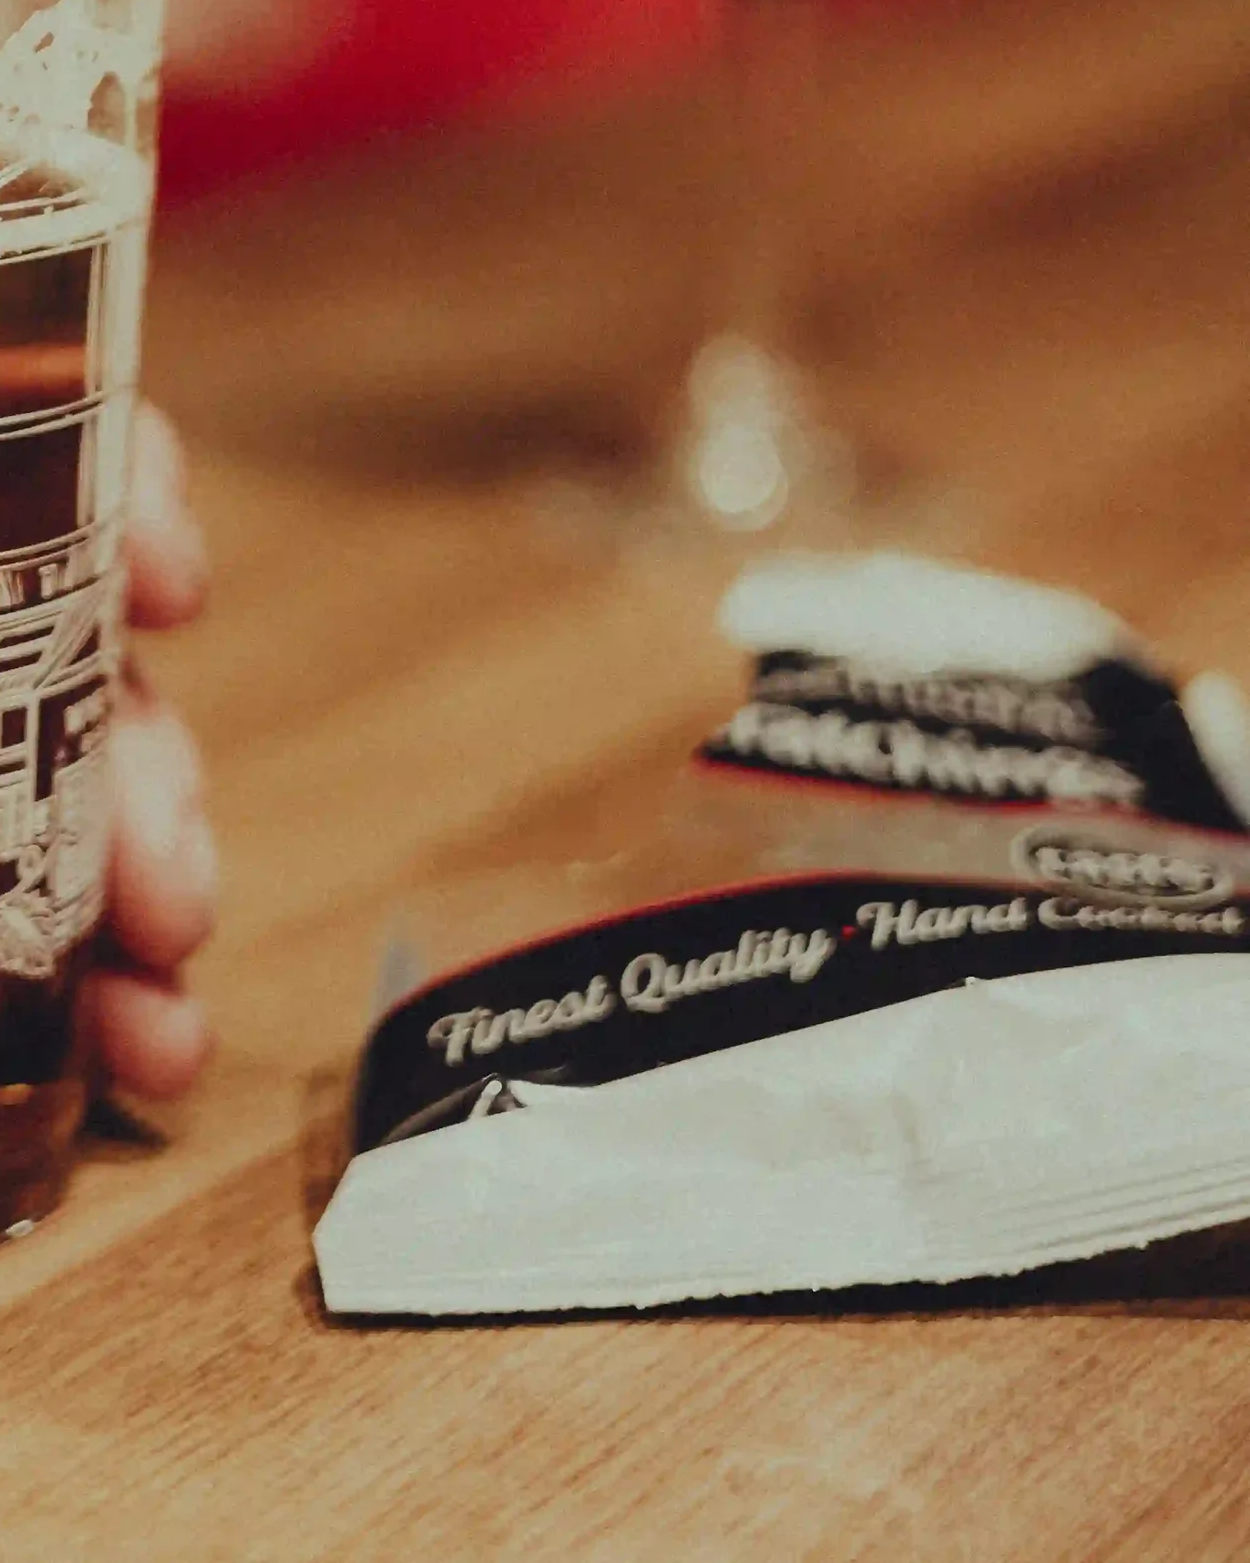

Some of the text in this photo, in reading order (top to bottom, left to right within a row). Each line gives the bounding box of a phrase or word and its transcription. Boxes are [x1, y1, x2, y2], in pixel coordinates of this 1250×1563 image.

[426, 973, 618, 1068] Finest
[620, 926, 838, 1014] Quality
[855, 896, 1029, 952] Hand
